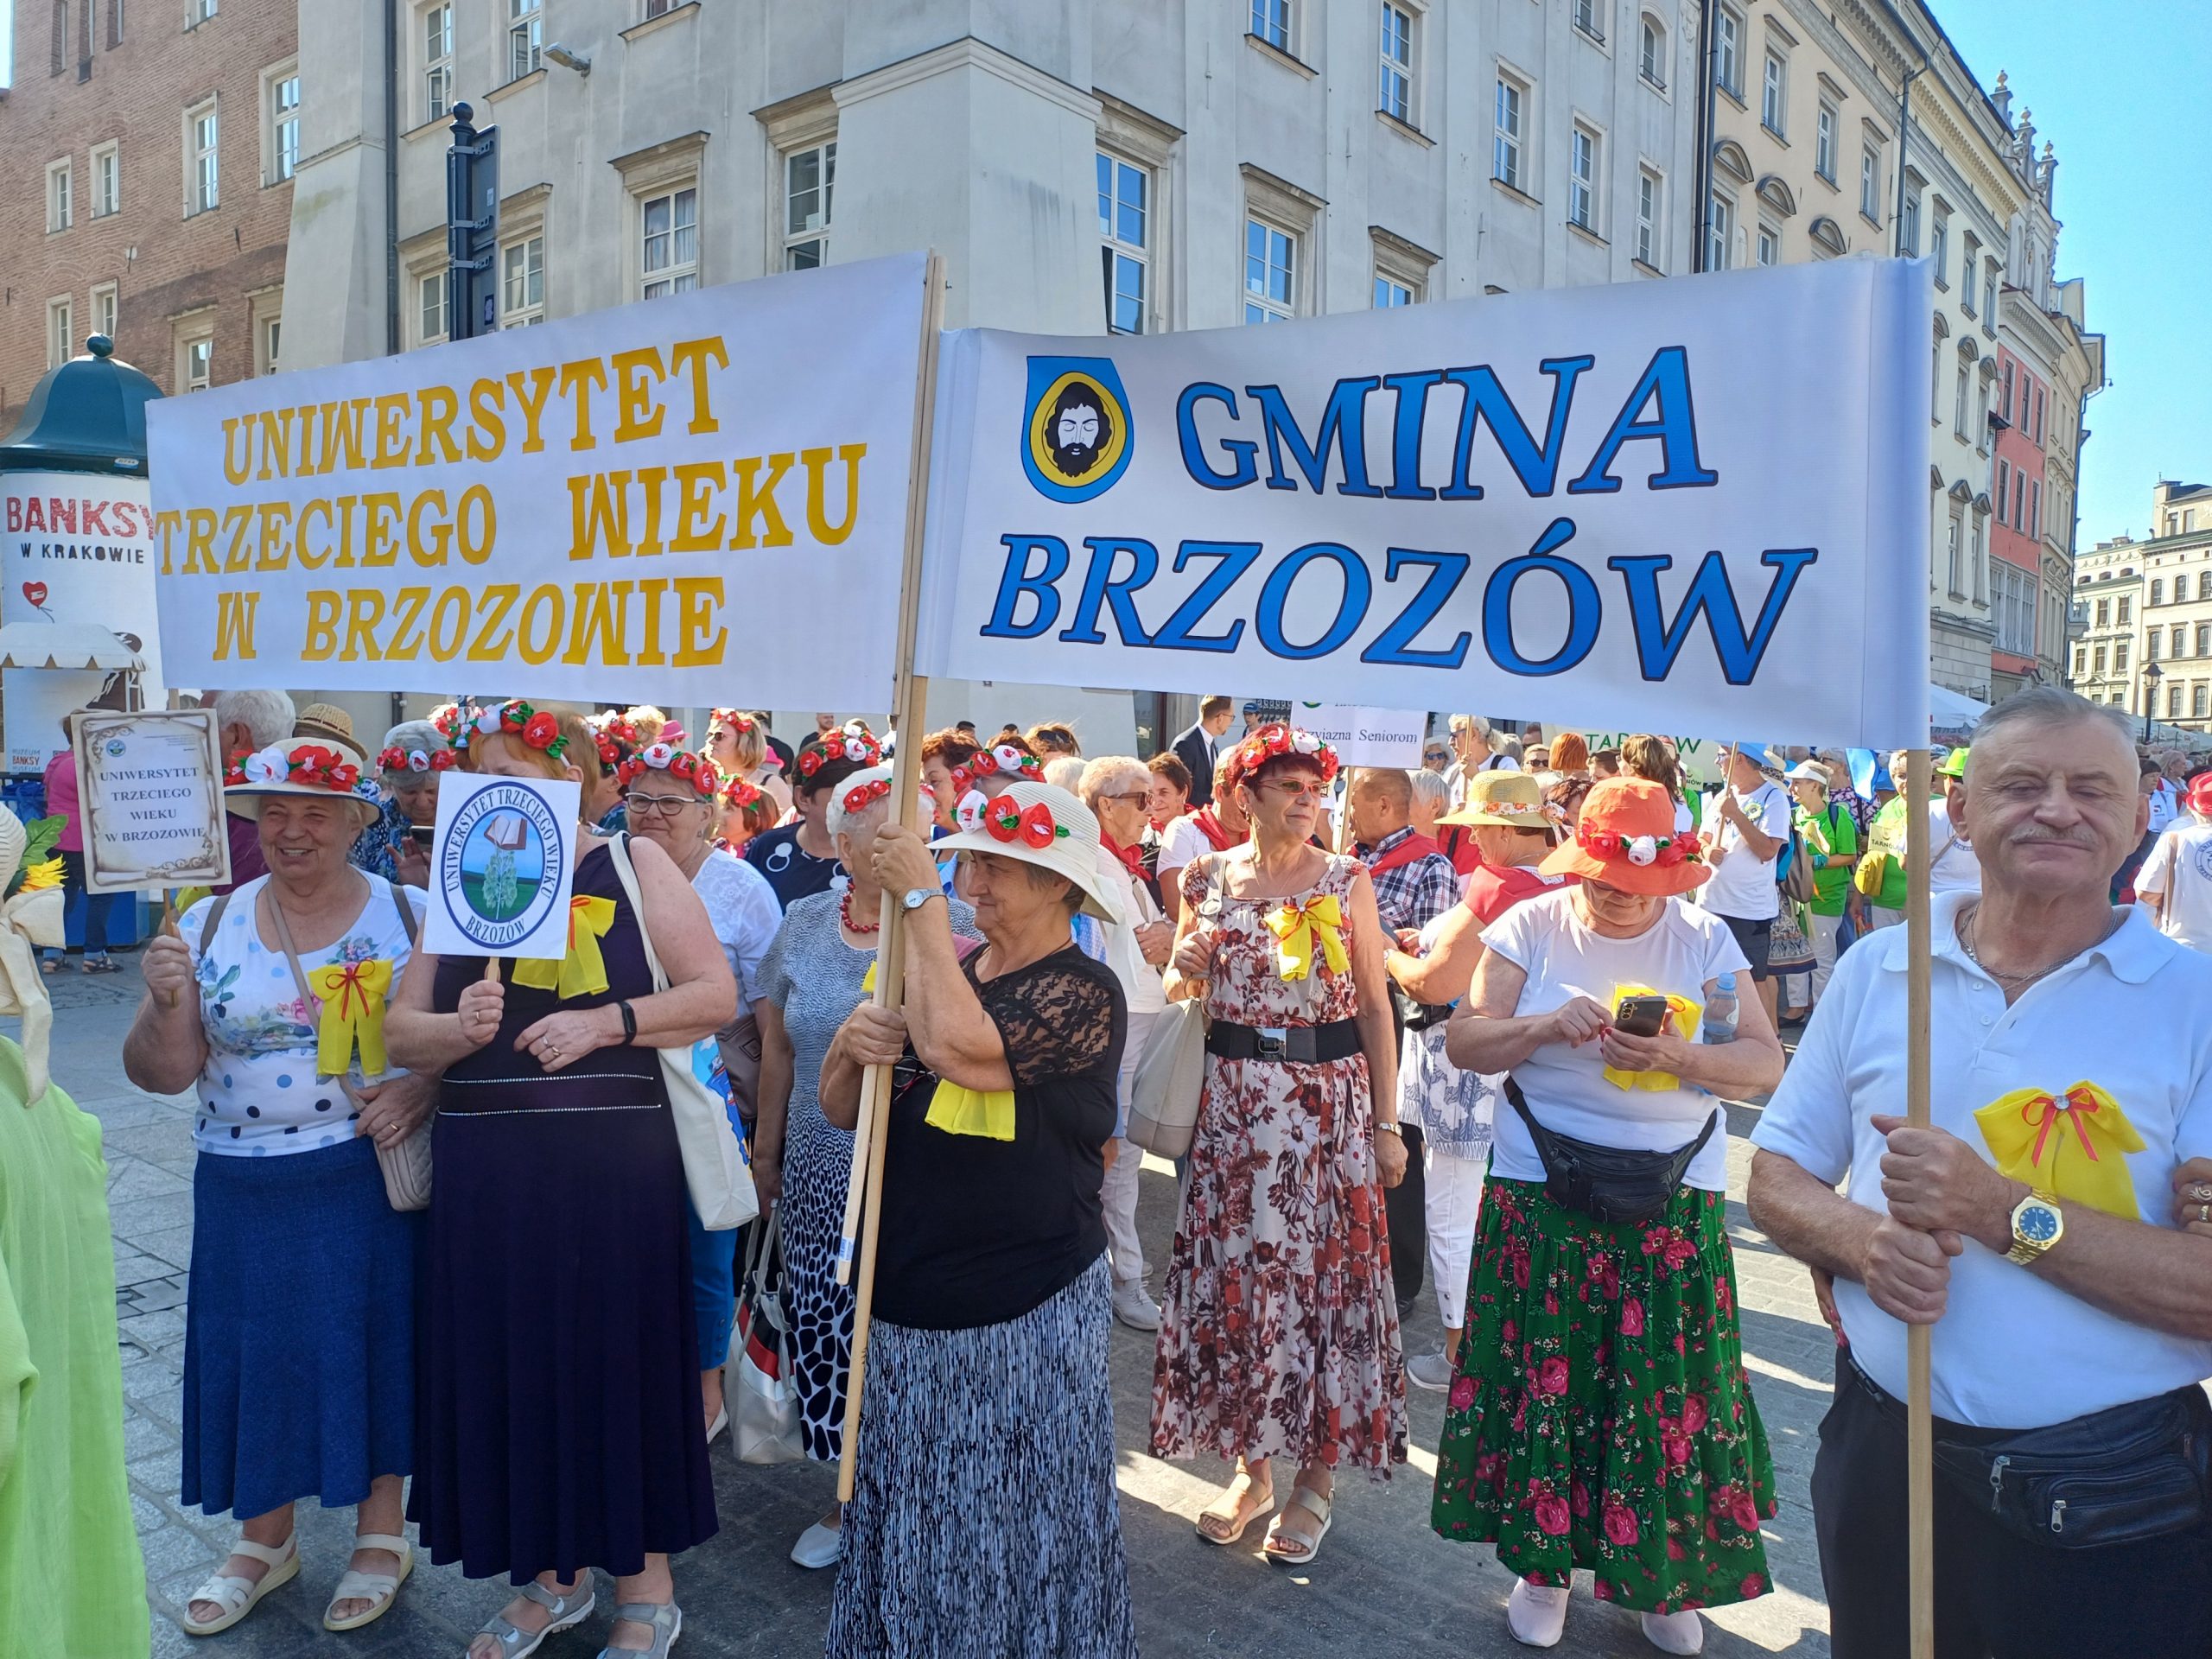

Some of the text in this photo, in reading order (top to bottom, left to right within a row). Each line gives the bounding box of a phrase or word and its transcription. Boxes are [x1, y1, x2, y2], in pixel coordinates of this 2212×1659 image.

[221, 335, 730, 486] UNIWERSYTET
[1176, 345, 1719, 502] GMINA
[156, 442, 867, 576] TRZECIEGO WIEKU
[21, 543, 144, 563] W KRAKOWIE
[979, 517, 1818, 685] BRZOZÓW
[213, 576, 728, 668] W BRZOZOWIE
[1358, 728, 1418, 744] Seniorom
[12, 755, 40, 766] BANKSY
[99, 767, 200, 781] UNIWERSYTET
[111, 788, 192, 801] TRZECIEGO
[130, 809, 177, 820] WIEKU
[105, 828, 206, 842] W BRZOZOWIE
[446, 788, 558, 899] UNIWERSYTET TRZECIEGO WIEKU
[465, 915, 526, 943] BRZOZÓW
